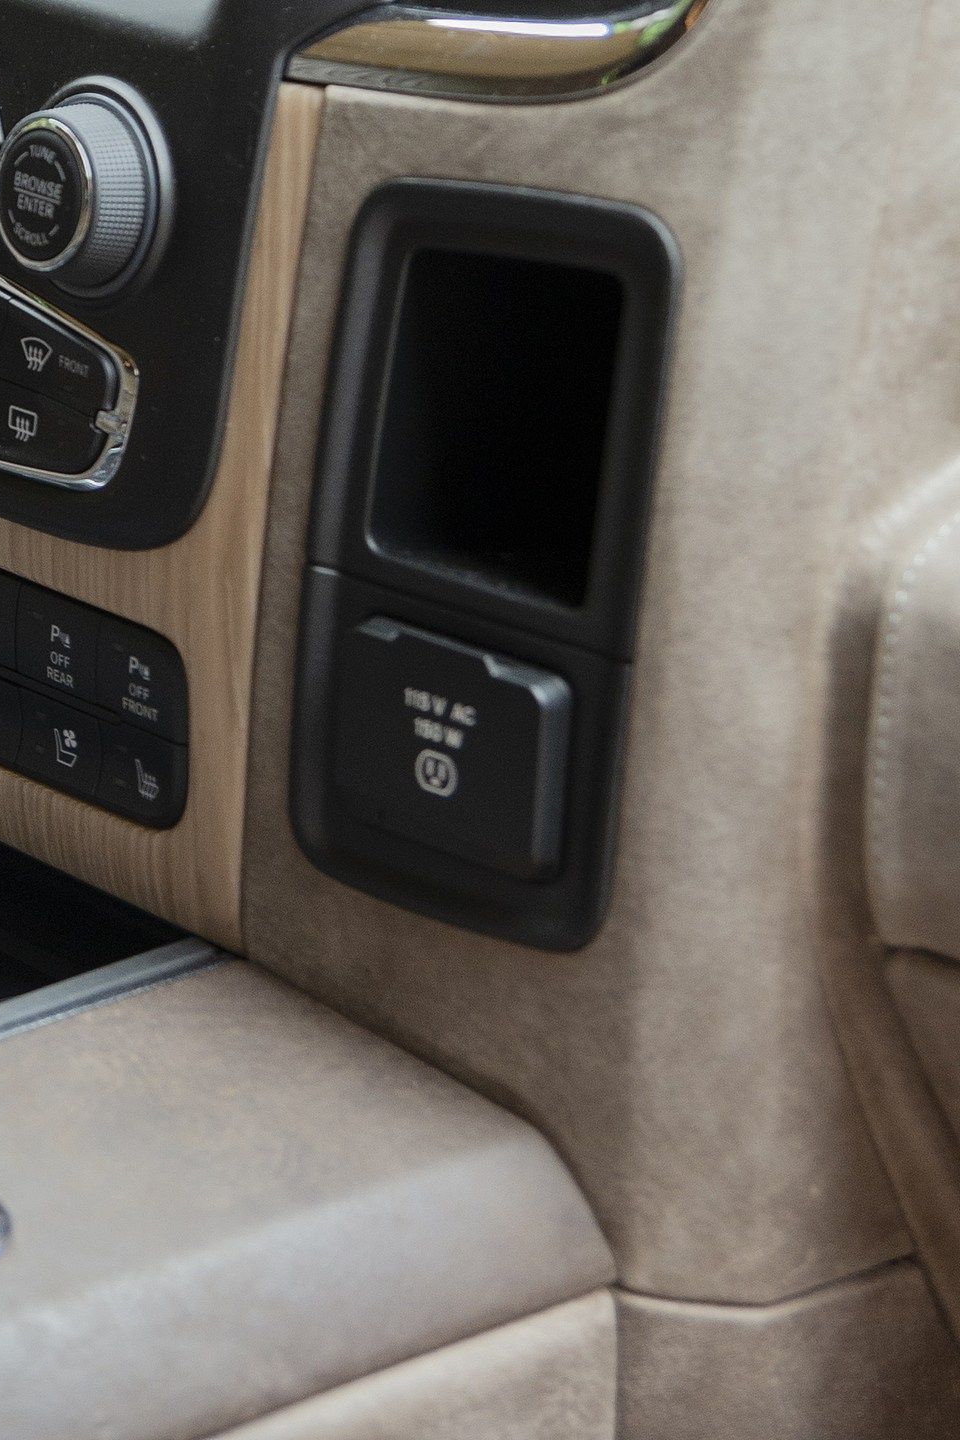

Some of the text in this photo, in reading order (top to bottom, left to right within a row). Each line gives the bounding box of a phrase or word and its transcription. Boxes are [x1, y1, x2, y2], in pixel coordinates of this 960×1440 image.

[14, 170, 64, 202] BROWSE
[17, 193, 55, 219] ENTER
[50, 651, 70, 669] OFF
[46, 666, 74, 689] REAR
[128, 682, 150, 701] OFF
[121, 696, 159, 722] FRONT
